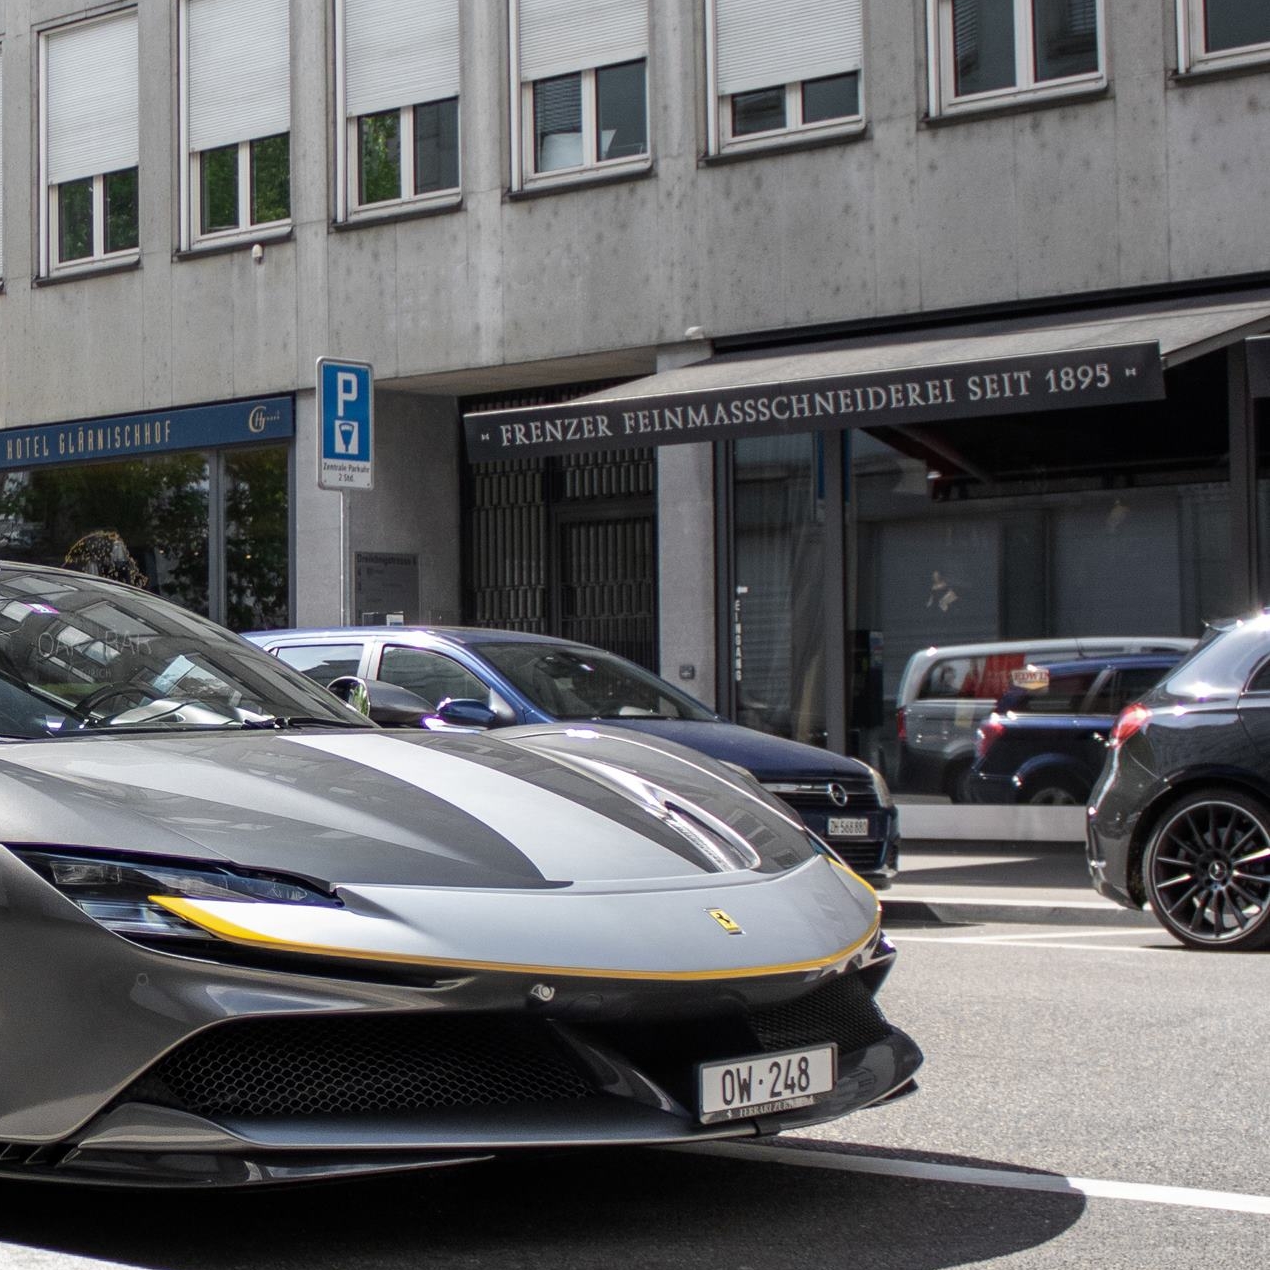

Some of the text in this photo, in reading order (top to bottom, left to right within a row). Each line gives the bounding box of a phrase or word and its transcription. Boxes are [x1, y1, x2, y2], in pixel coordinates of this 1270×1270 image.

[337, 371, 358, 417] P
[500, 362, 1112, 447] FRENZER FEINMASSSCHNEIDEREI SEIT 1895
[6, 420, 171, 460] HOTEL GLÄRNISCHHOF
